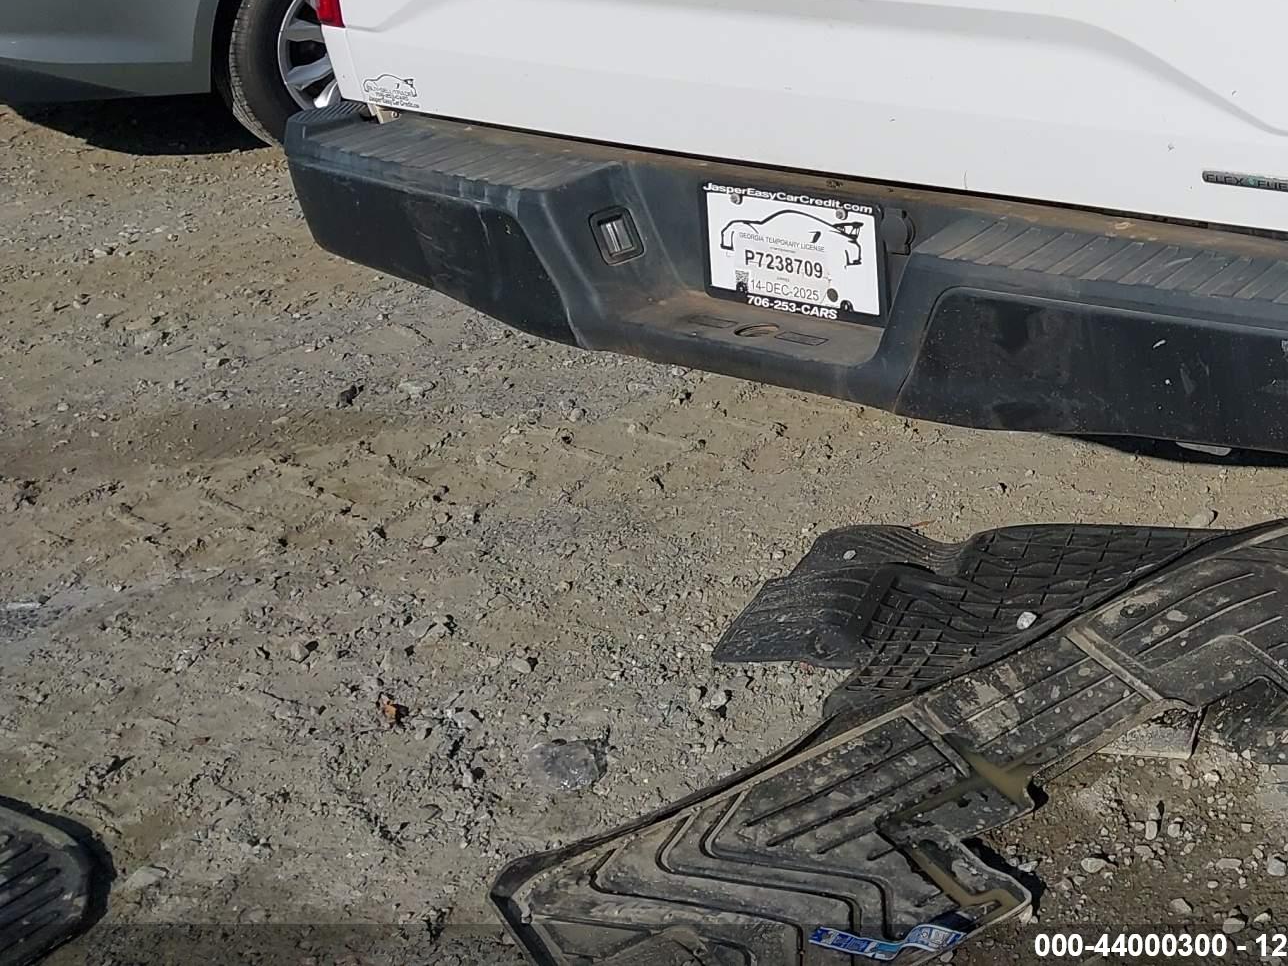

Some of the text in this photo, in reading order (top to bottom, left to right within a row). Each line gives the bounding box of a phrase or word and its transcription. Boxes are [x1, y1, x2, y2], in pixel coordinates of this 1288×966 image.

[702, 182, 873, 214] JasperEasyCarCredit.com
[765, 236, 800, 249] TEMPORARY
[744, 249, 823, 279] P7238709
[750, 278, 819, 302] 14-DEC-2025
[746, 295, 838, 319] 706-253-CARS
